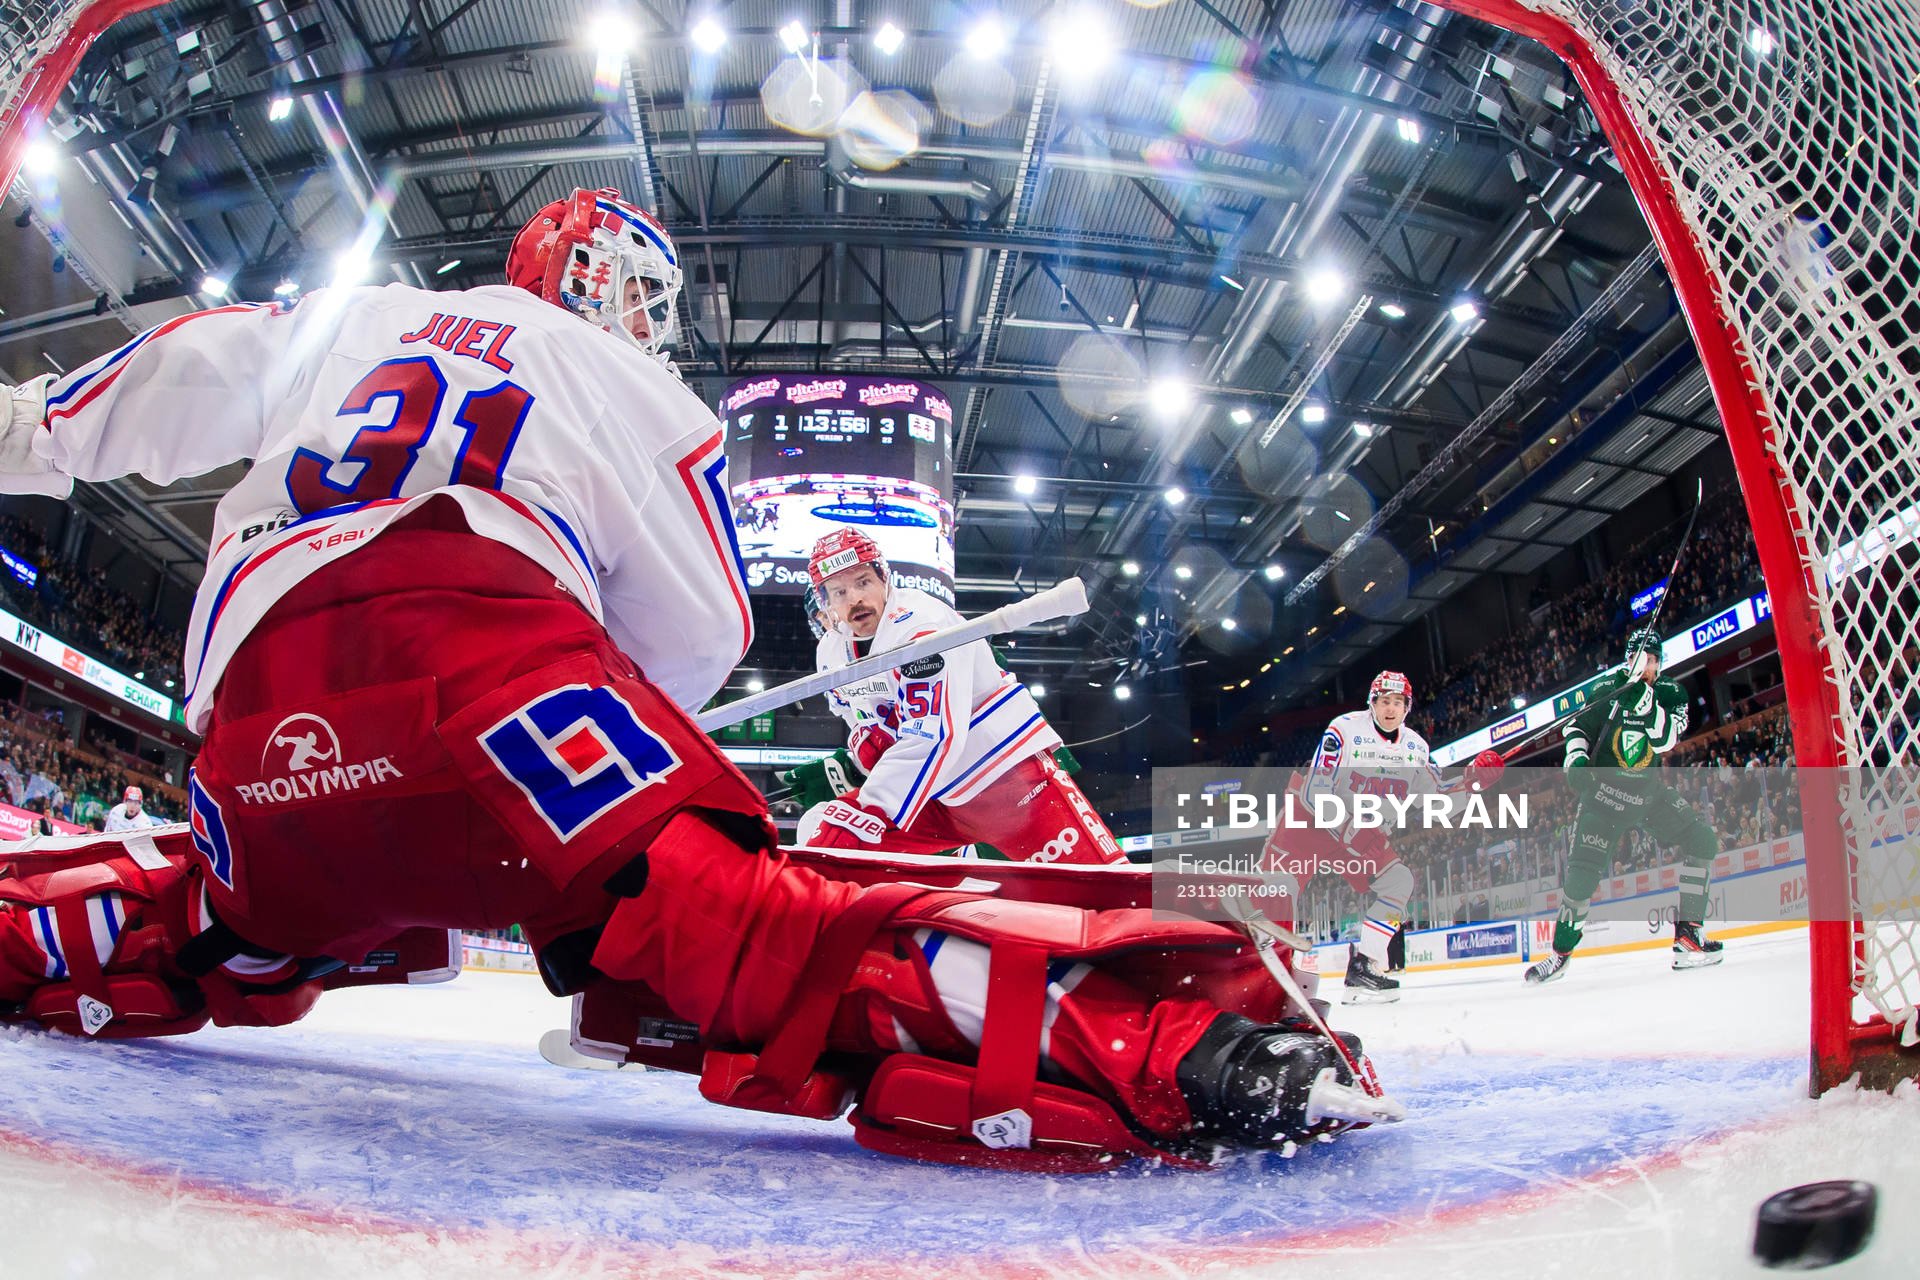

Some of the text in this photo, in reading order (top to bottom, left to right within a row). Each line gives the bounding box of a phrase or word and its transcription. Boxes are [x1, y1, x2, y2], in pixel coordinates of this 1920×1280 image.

[400, 313, 517, 374] JUEL
[774, 414, 789, 431] 1
[803, 415, 866, 434] 13:56
[880, 417, 895, 435] 3
[285, 355, 536, 516] 31
[829, 550, 858, 568] LILIUM
[775, 565, 812, 584] Sve
[15, 621, 42, 652] NWT
[124, 685, 162, 713] SCHAKT
[905, 680, 943, 719] 51
[235, 756, 404, 804] PROLYMPIA
[1594, 791, 1625, 812] Energi
[1600, 782, 1644, 806] Karlstads
[1582, 833, 1609, 849] voky
[1451, 935, 1468, 951] Max
[1411, 950, 1433, 963] frakt
